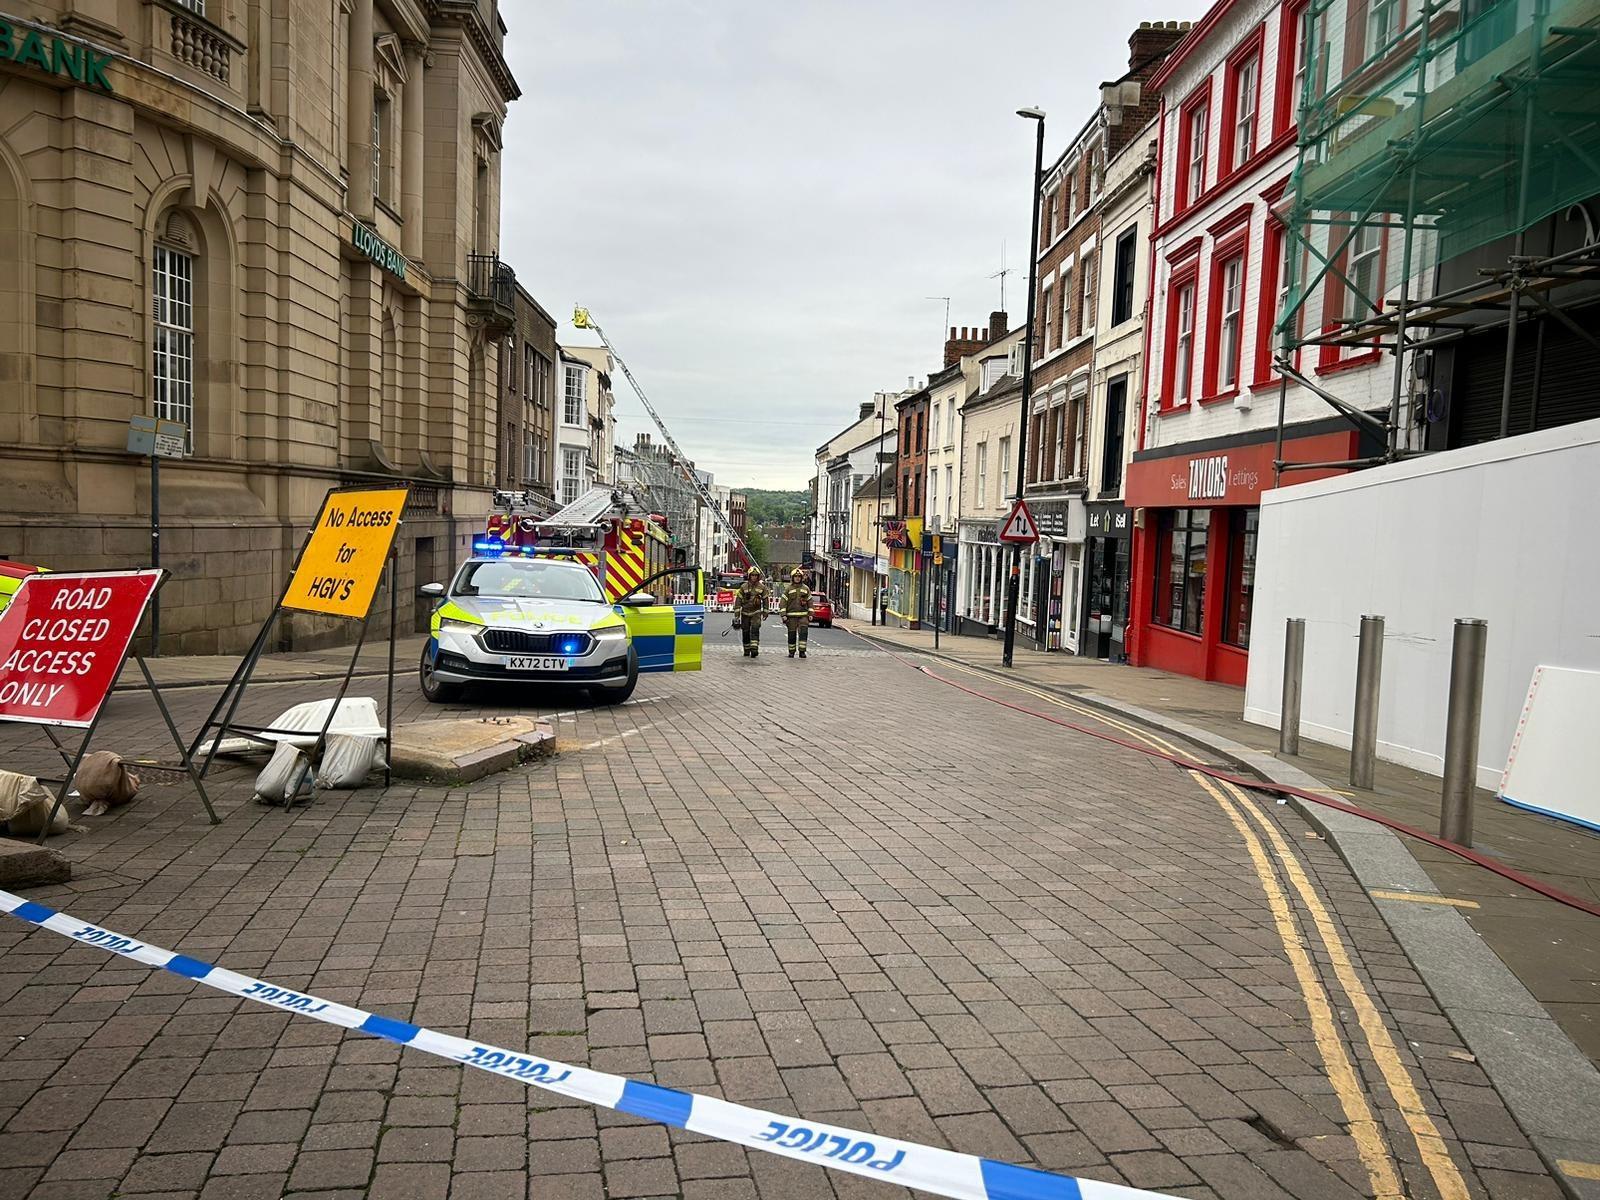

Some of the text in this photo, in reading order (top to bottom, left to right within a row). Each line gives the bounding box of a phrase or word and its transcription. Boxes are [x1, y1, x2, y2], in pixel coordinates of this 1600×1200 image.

[0, 19, 113, 91] BANK
[355, 225, 407, 278] LLOYDS BANK
[1170, 455, 1259, 499] Sales TAYLORS Lettings
[325, 506, 393, 527] No Access
[335, 542, 356, 563] for
[50, 587, 112, 611] ROAD
[307, 576, 354, 600] HGV'S
[22, 618, 110, 642] CLOSED
[0, 649, 96, 675] ACCESS
[510, 657, 565, 669] KX72 CTV
[0, 681, 64, 707] ONLY
[72, 926, 143, 954] POLICE
[241, 982, 329, 1014] POLICE
[460, 1047, 571, 1084] POLICE
[750, 1121, 907, 1173] POLICE
